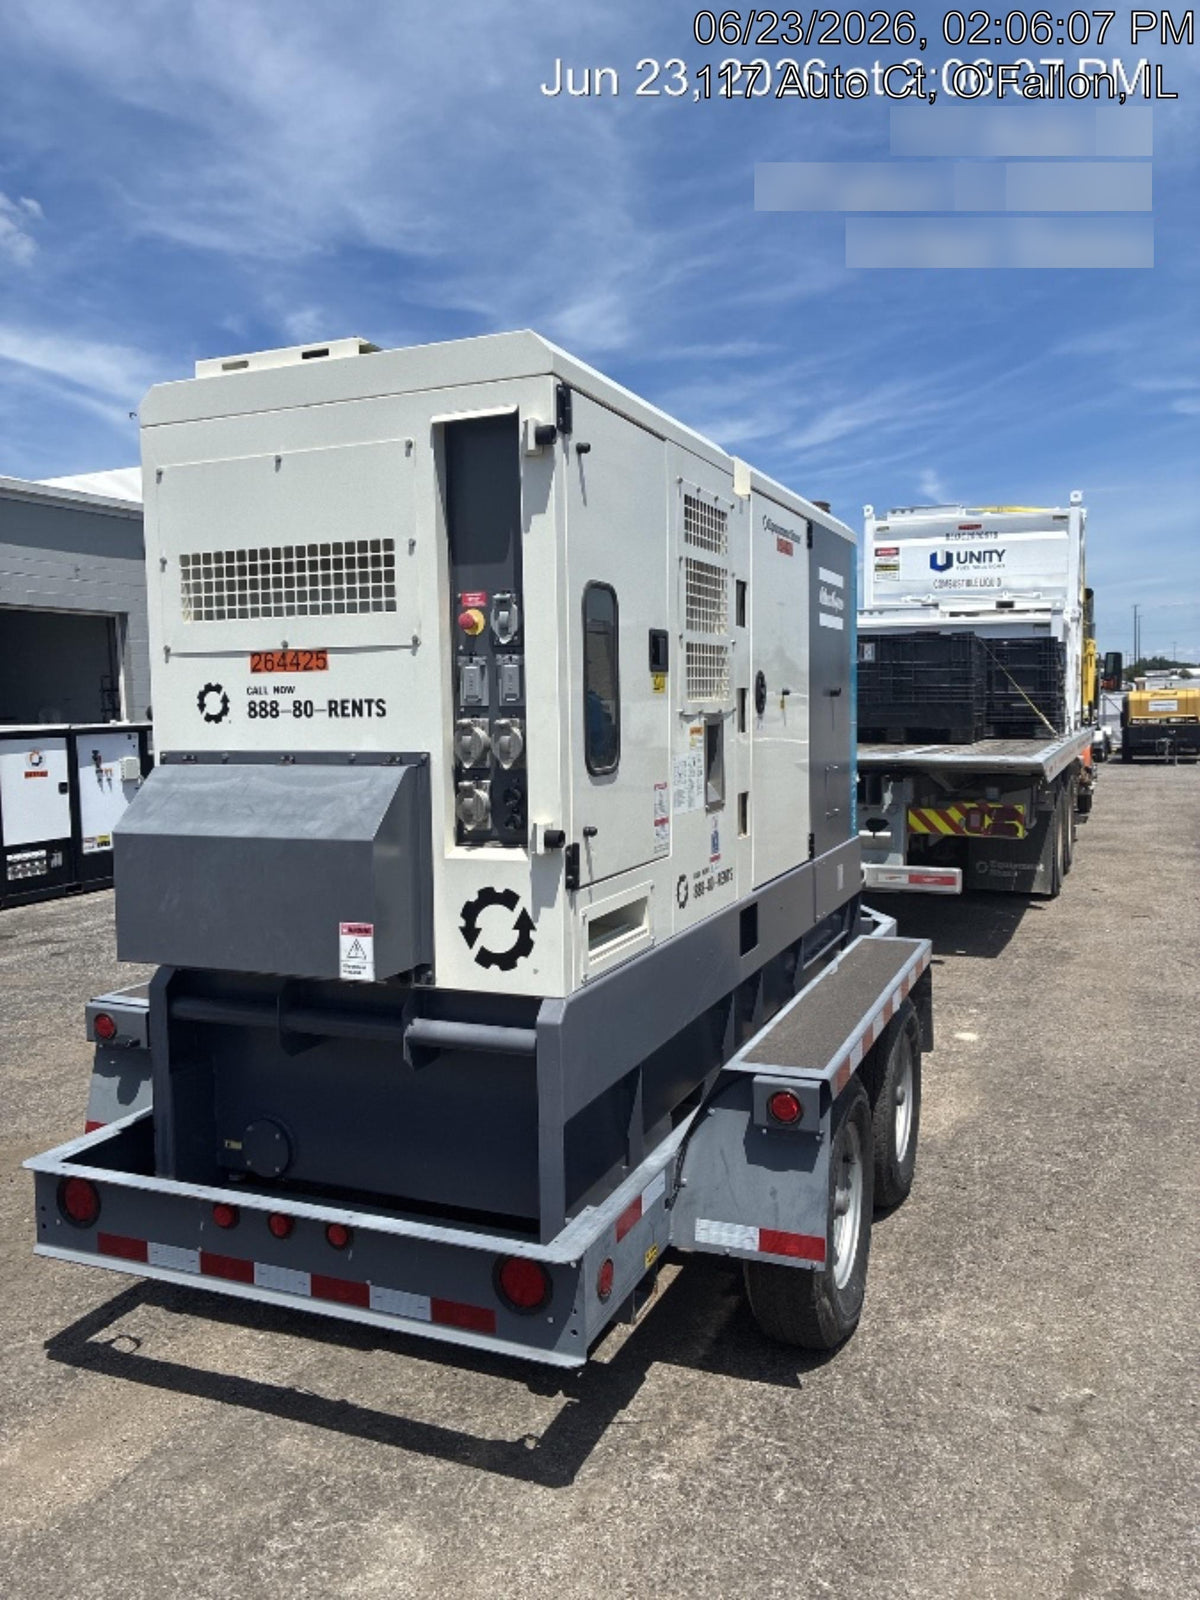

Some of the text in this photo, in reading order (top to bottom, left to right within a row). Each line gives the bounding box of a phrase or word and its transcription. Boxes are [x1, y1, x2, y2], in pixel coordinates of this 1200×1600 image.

[956, 549, 1006, 564] UNITY
[251, 650, 327, 672] 264425
[246, 686, 296, 695] CALL NOW
[248, 698, 387, 719] 888-80-RENTS
